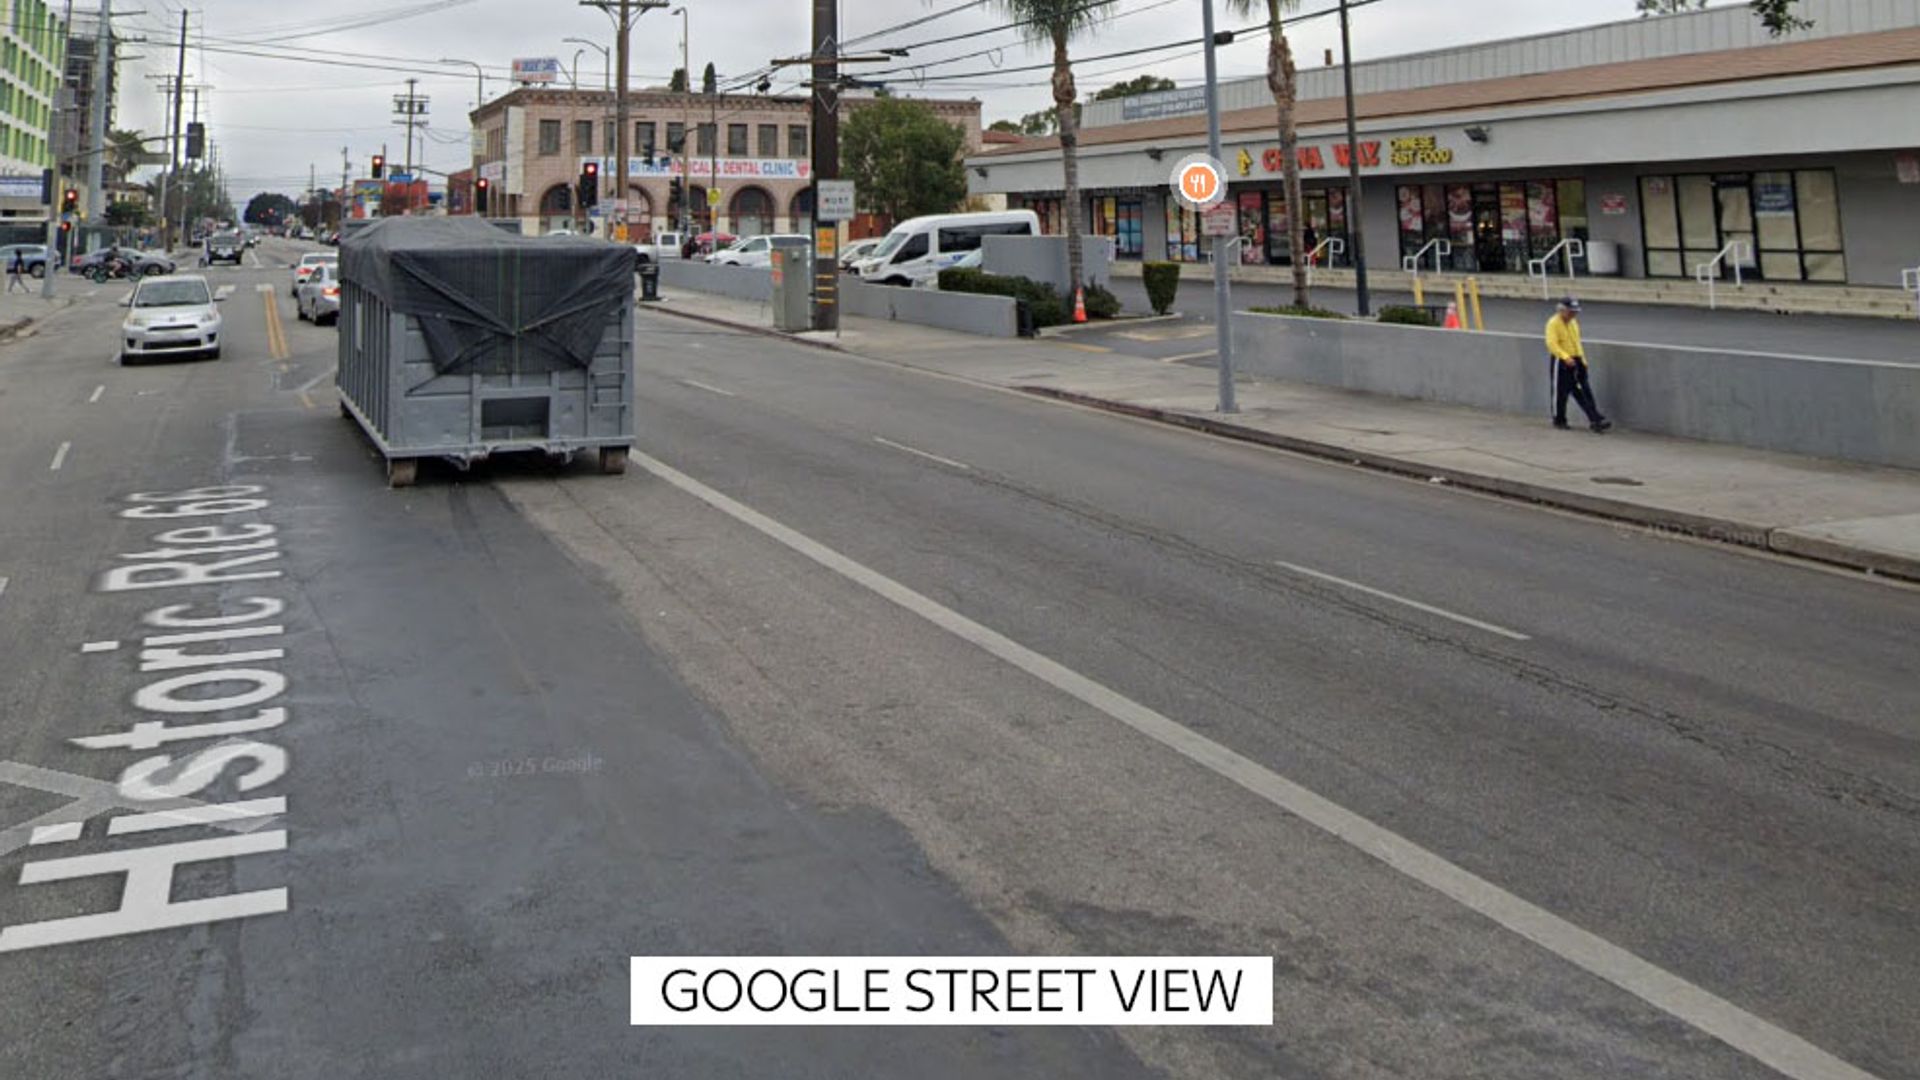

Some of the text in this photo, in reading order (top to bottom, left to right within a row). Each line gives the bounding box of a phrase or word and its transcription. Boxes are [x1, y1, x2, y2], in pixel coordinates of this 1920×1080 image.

[1262, 145, 1324, 174] CHNA
[1419, 148, 1453, 165] FOOD
[723, 161, 760, 174] DENTAL
[762, 162, 793, 175] CLINIC
